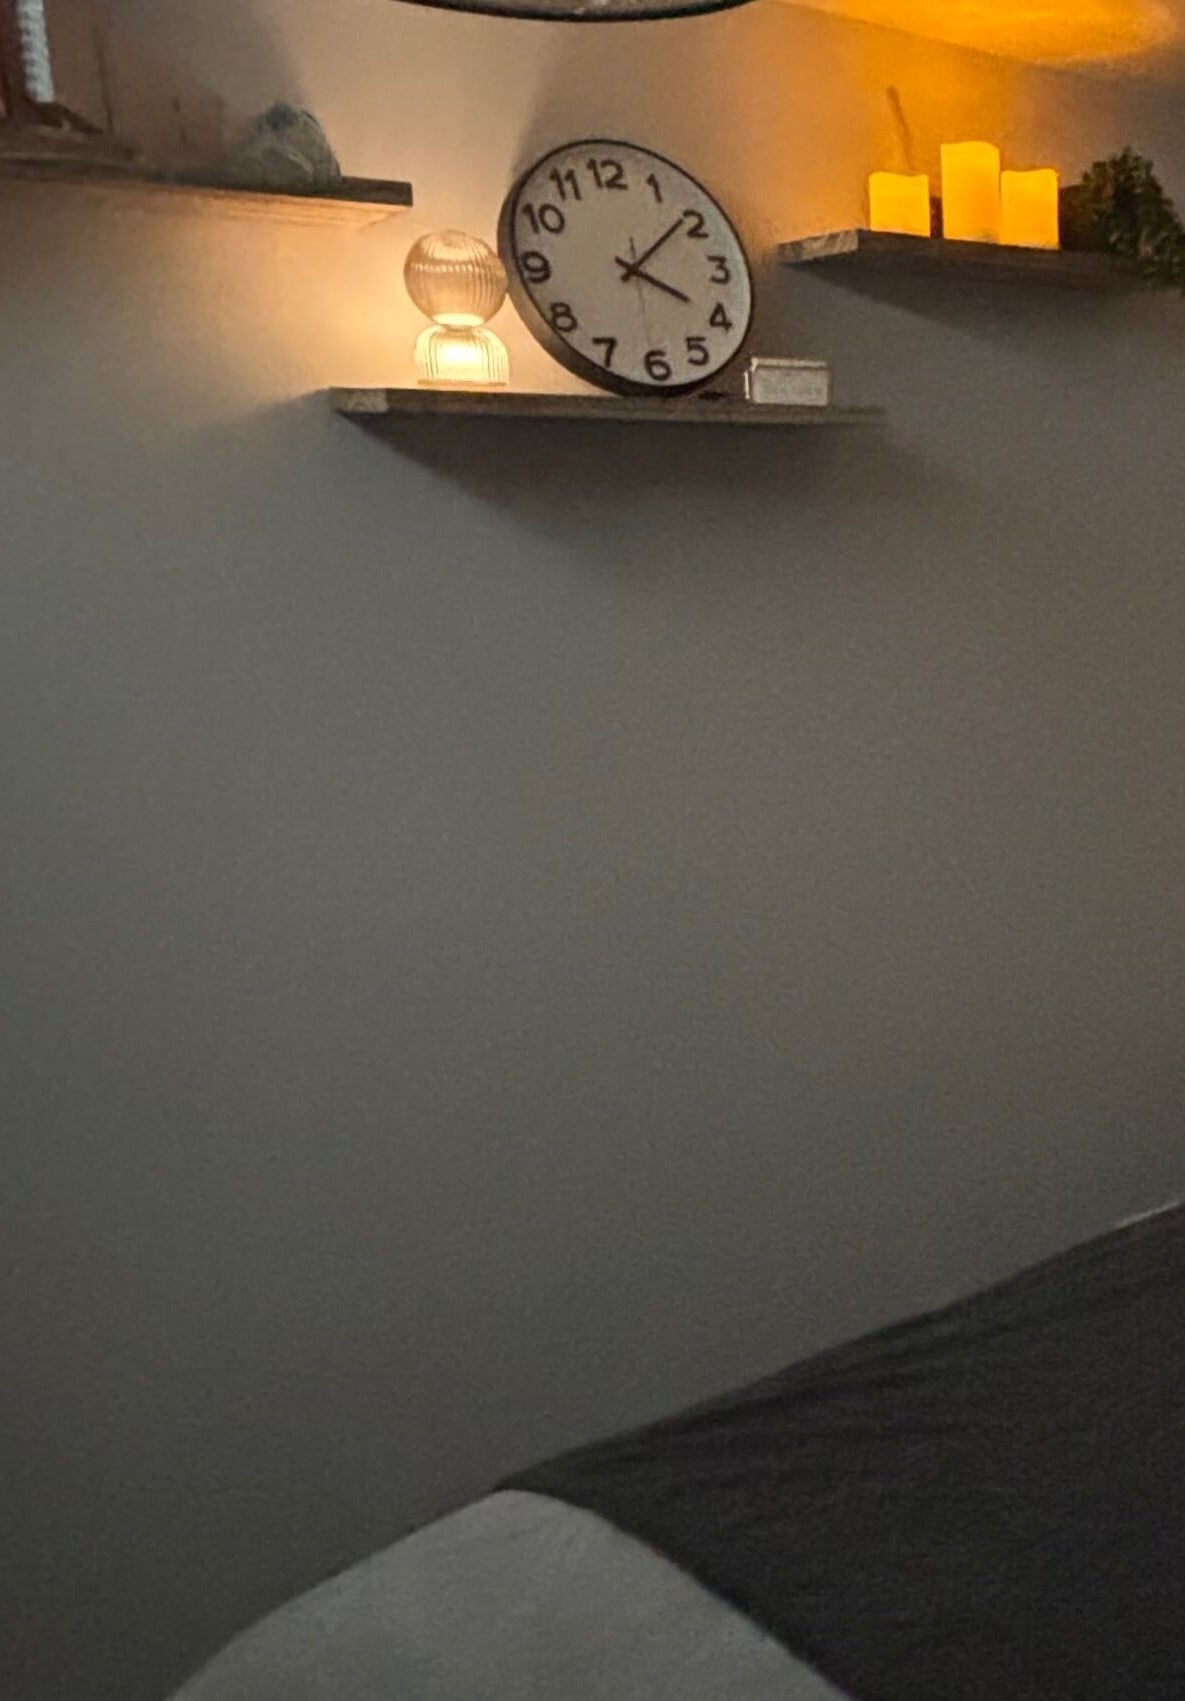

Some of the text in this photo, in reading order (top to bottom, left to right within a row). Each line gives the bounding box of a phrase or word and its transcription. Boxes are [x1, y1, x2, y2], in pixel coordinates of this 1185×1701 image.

[550, 167, 582, 201] 11
[587, 158, 628, 191] 12
[647, 173, 663, 204] 1
[521, 202, 566, 235] 10
[683, 209, 710, 239] 2
[522, 250, 552, 284] 9
[707, 255, 731, 285] 3
[550, 301, 578, 333] 8
[709, 303, 733, 333] 4
[592, 336, 618, 368] 7
[644, 350, 673, 382] 6
[685, 336, 711, 367] 5
